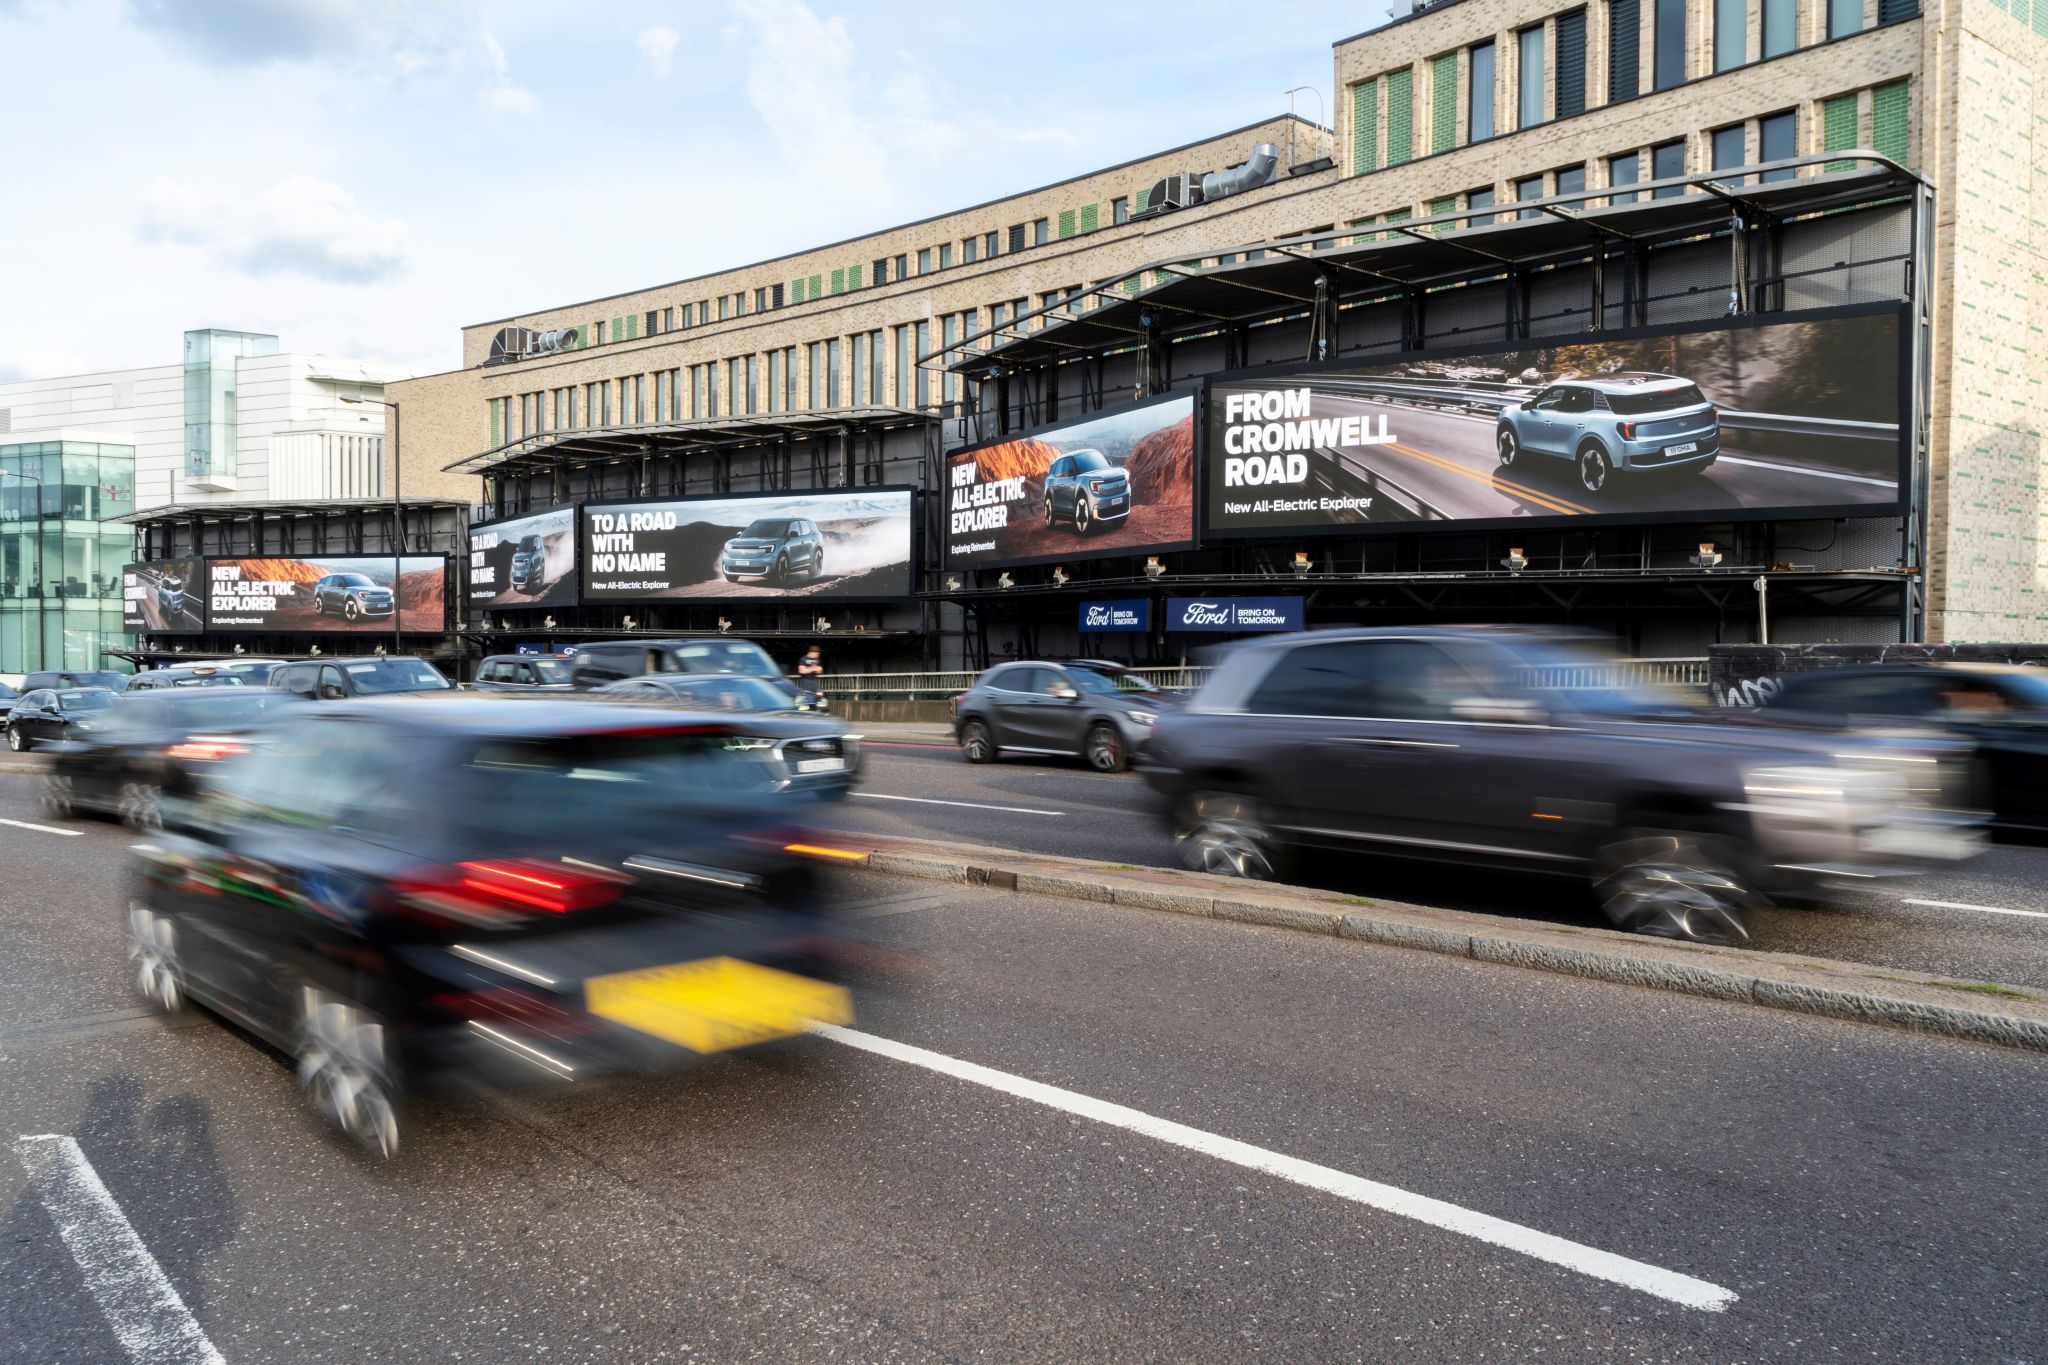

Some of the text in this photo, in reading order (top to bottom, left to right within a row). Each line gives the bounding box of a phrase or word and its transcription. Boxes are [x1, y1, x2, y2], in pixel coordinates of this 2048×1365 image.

[1226, 388, 1310, 423] FROM
[1225, 414, 1397, 454] CROMWELL
[952, 462, 976, 487] NEW
[1225, 454, 1308, 487] ROAD
[952, 476, 1025, 511] ALL-ELECTRIC
[1225, 497, 1372, 514] New All-Electric Explorer
[592, 512, 677, 532] TO A ROAD
[952, 505, 1007, 534] EXPLORER
[592, 533, 633, 552] WITH
[952, 540, 995, 555] Exploring Reinvented
[592, 553, 666, 572] NO NAME
[212, 566, 240, 580] NEW
[212, 581, 296, 595] ALL-ELECTRIC
[608, 581, 641, 589] All-Electric
[643, 581, 669, 590] Explorer
[212, 597, 276, 610] EXPLORER
[1086, 606, 1109, 625] Ford
[1183, 603, 1229, 624] Ford
[1238, 616, 1285, 624] TOMORROW
